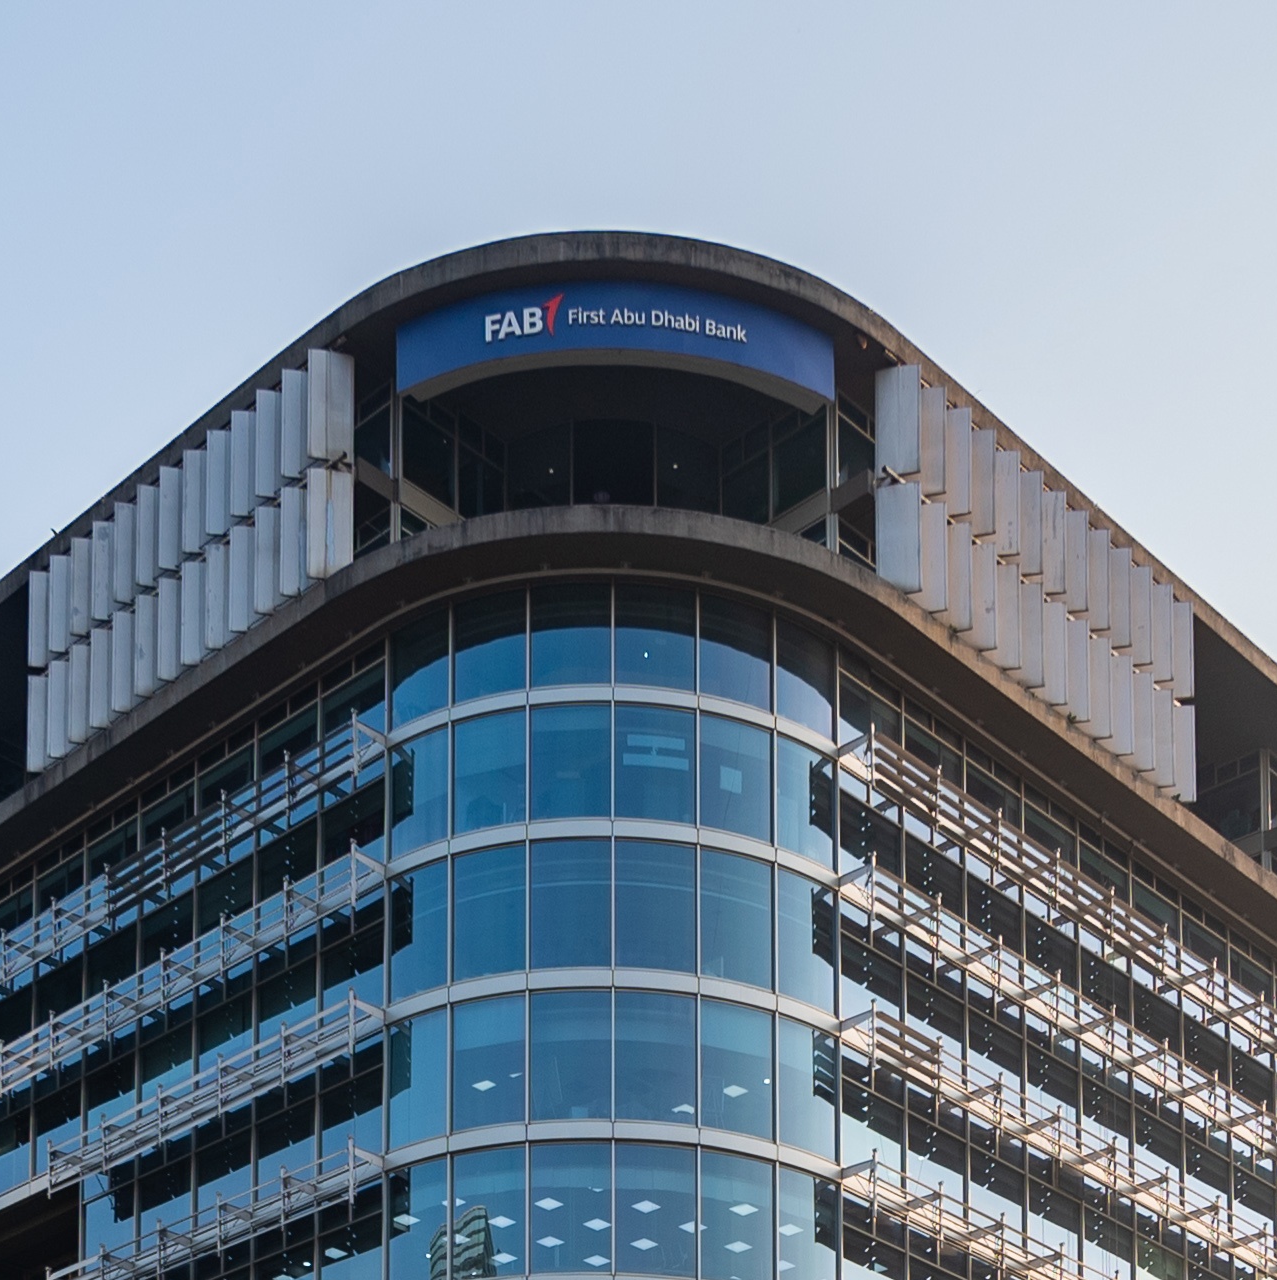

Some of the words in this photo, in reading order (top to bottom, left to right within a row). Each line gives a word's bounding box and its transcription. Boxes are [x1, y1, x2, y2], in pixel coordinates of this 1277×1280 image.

[484, 306, 544, 343] FAB
[568, 307, 606, 326] First
[610, 307, 646, 326] Abu
[650, 309, 700, 333] Dhabi
[705, 319, 747, 343] Bank
